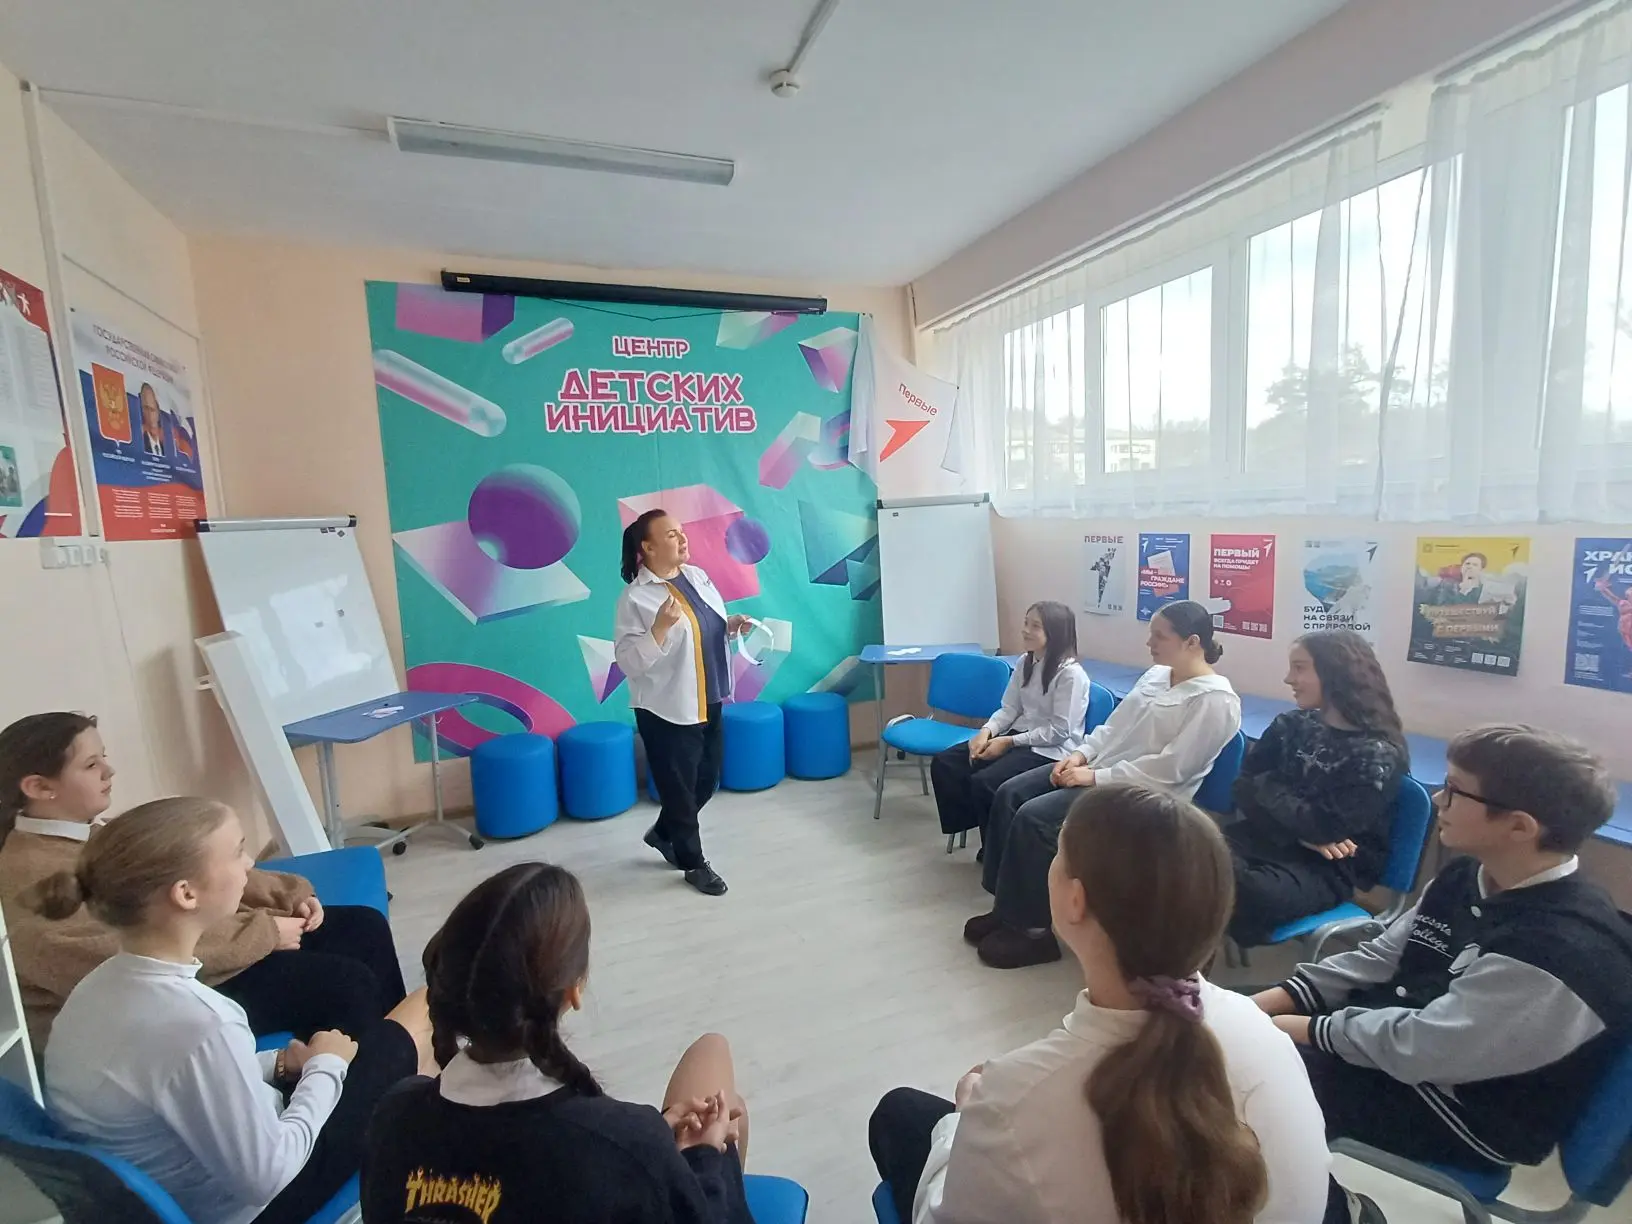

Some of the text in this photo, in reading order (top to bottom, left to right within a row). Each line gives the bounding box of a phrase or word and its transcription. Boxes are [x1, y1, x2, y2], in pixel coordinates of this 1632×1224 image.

[613, 337, 689, 357] ЦЕНТР
[559, 369, 743, 402] ДЕТСКИХ
[546, 403, 756, 433] ИНИЦИАТИВ
[1084, 535, 1124, 544] ПЕРВЫЕ
[1213, 547, 1260, 558] ПЕРВЫЙ
[1150, 575, 1185, 583] ГРАЖДАНЕ
[1304, 605, 1327, 613] БУД
[1319, 614, 1354, 622] СВЯЗИ
[1312, 622, 1371, 631] ПРИРОДОЙ
[404, 1165, 502, 1224] THRASHER
